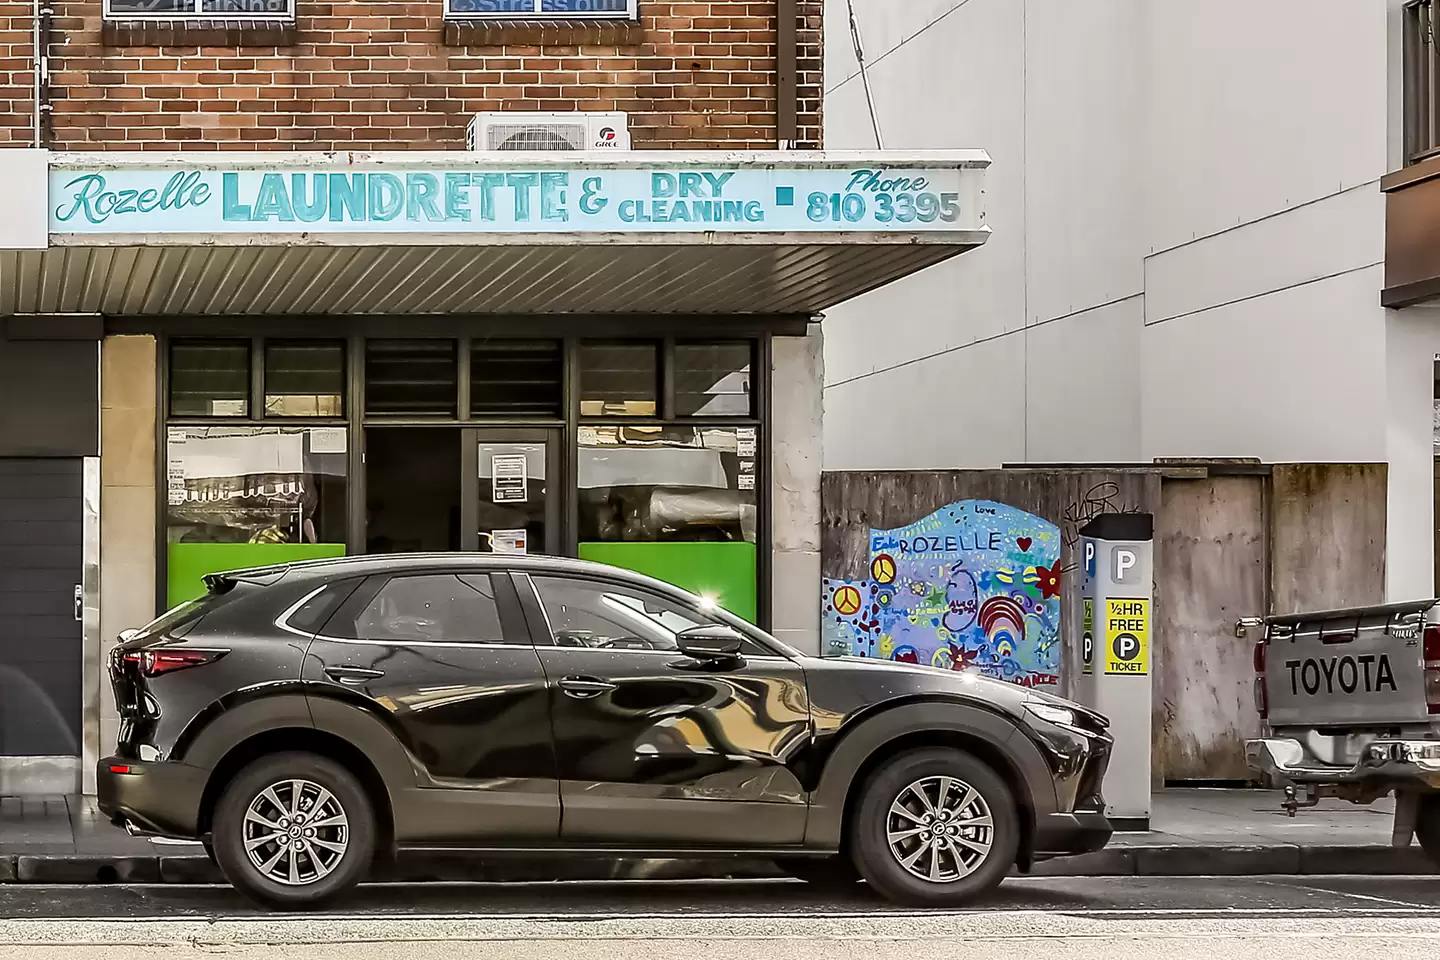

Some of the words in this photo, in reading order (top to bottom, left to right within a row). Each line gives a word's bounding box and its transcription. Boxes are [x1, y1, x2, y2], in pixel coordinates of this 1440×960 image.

[651, 171, 736, 199] DRY
[845, 169, 931, 194] Phone
[55, 170, 212, 224] Rozelle
[222, 172, 569, 223] LAUNDRETTE
[579, 176, 608, 216] &
[806, 192, 866, 223] 810
[875, 192, 959, 223] 3395
[618, 199, 765, 224] CLEANING
[974, 505, 997, 515] Love
[899, 532, 1002, 553] ROZELLE
[1117, 550, 1136, 579] P
[1109, 619, 1144, 631] FREE
[1120, 637, 1135, 657] P
[1110, 662, 1142, 671] TICKET
[1286, 654, 1398, 695] TOYOTA
